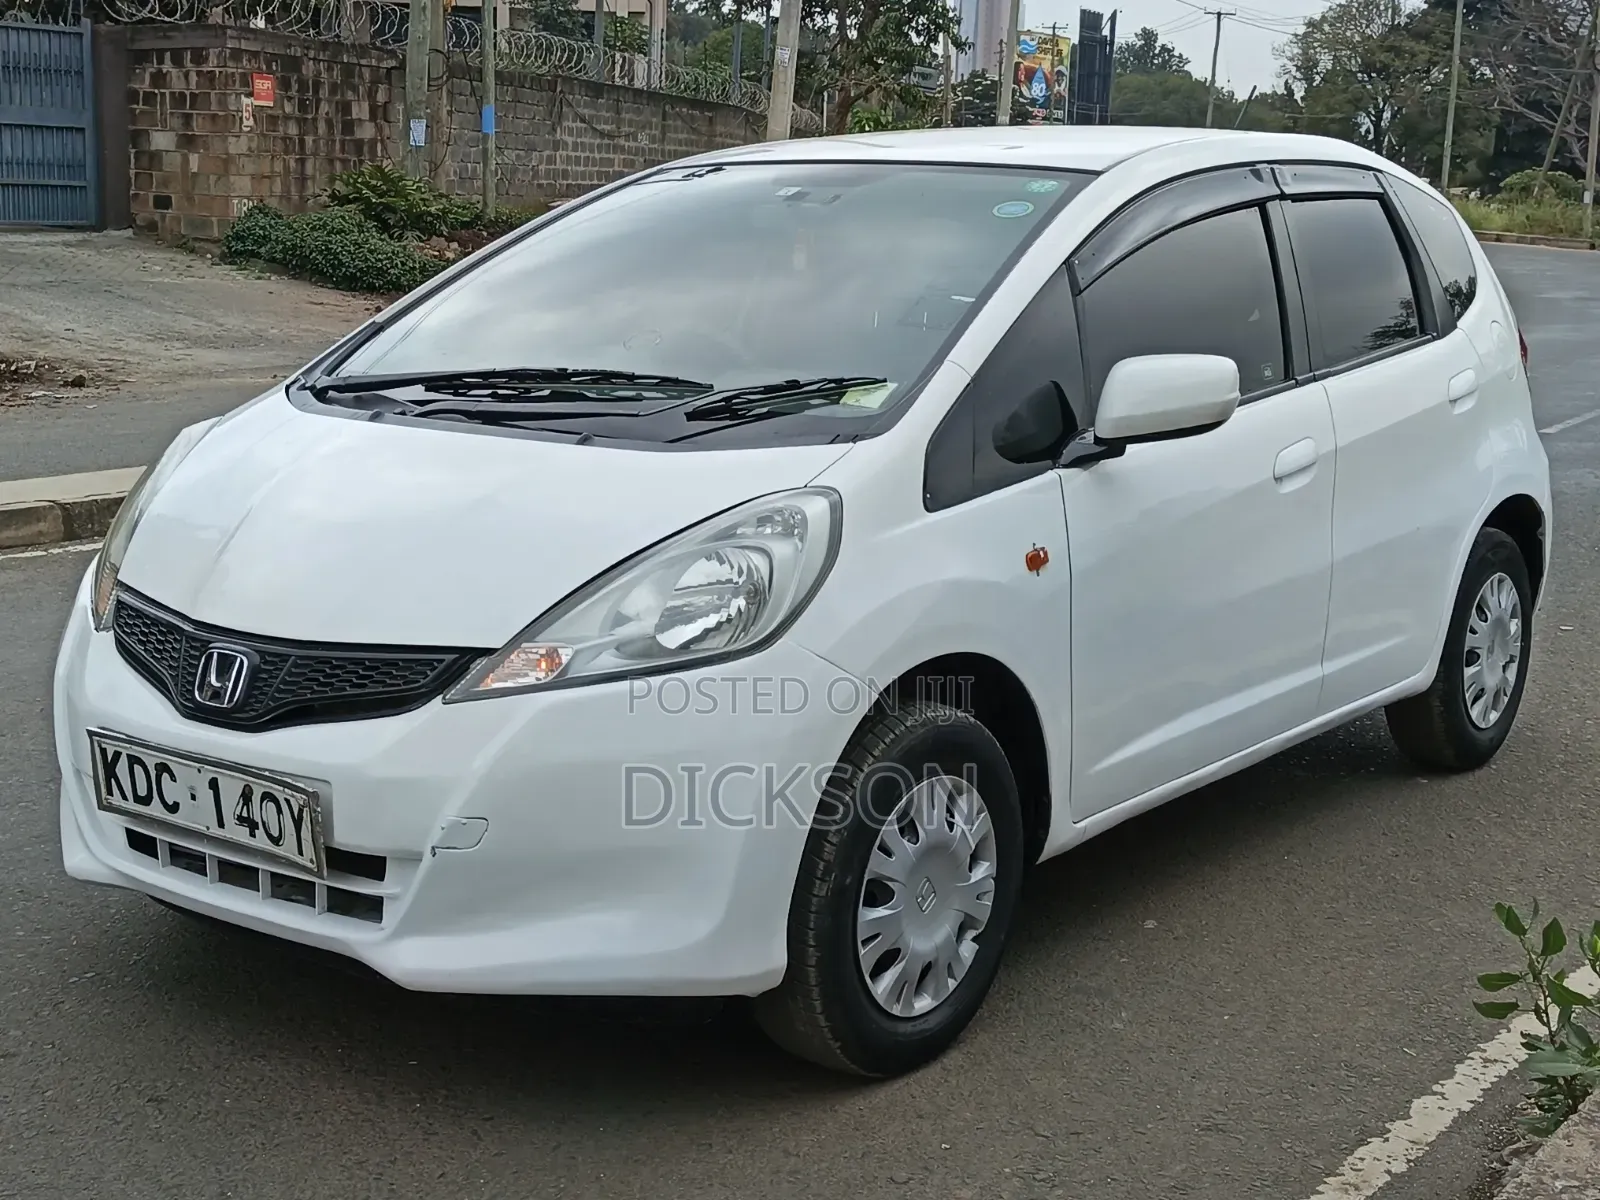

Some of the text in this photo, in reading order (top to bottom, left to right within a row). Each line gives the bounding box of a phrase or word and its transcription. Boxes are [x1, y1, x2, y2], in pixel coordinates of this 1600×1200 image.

[1031, 82, 1046, 97] 80
[244, 103, 252, 121] 5
[100, 746, 306, 858] KDC 140Y
